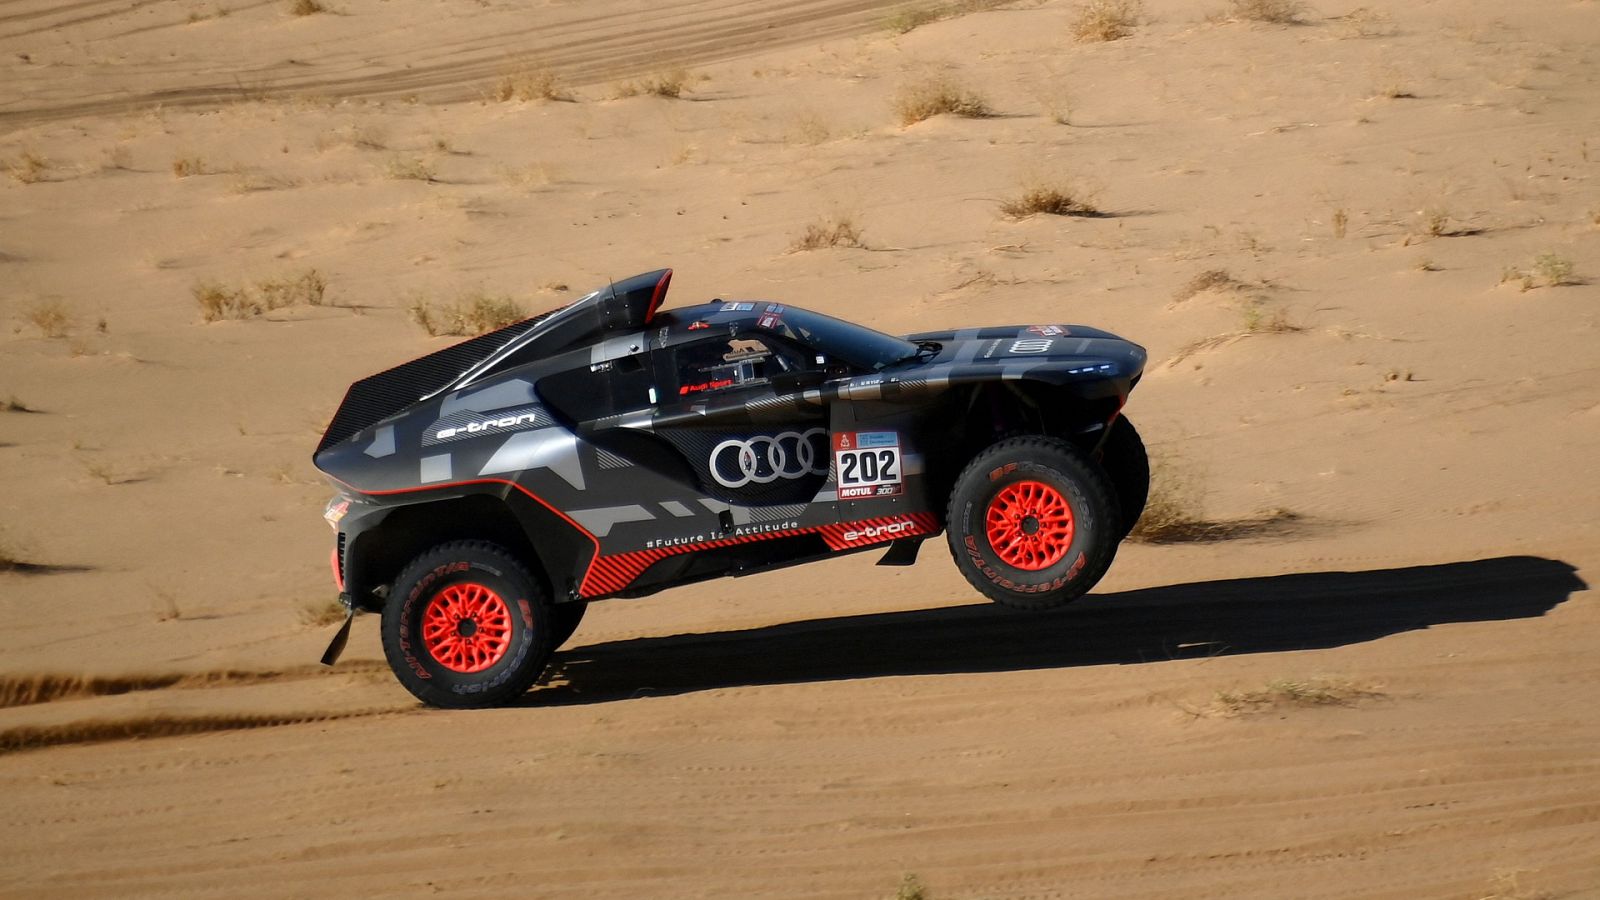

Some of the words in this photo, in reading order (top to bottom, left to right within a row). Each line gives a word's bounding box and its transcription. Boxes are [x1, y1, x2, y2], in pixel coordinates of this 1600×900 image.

[436, 413, 536, 439] e-tron
[841, 450, 897, 484] 202
[842, 487, 872, 497] MOTUL
[646, 534, 704, 549] #Future
[736, 520, 800, 537] Attitude
[843, 520, 915, 541] e-tron
